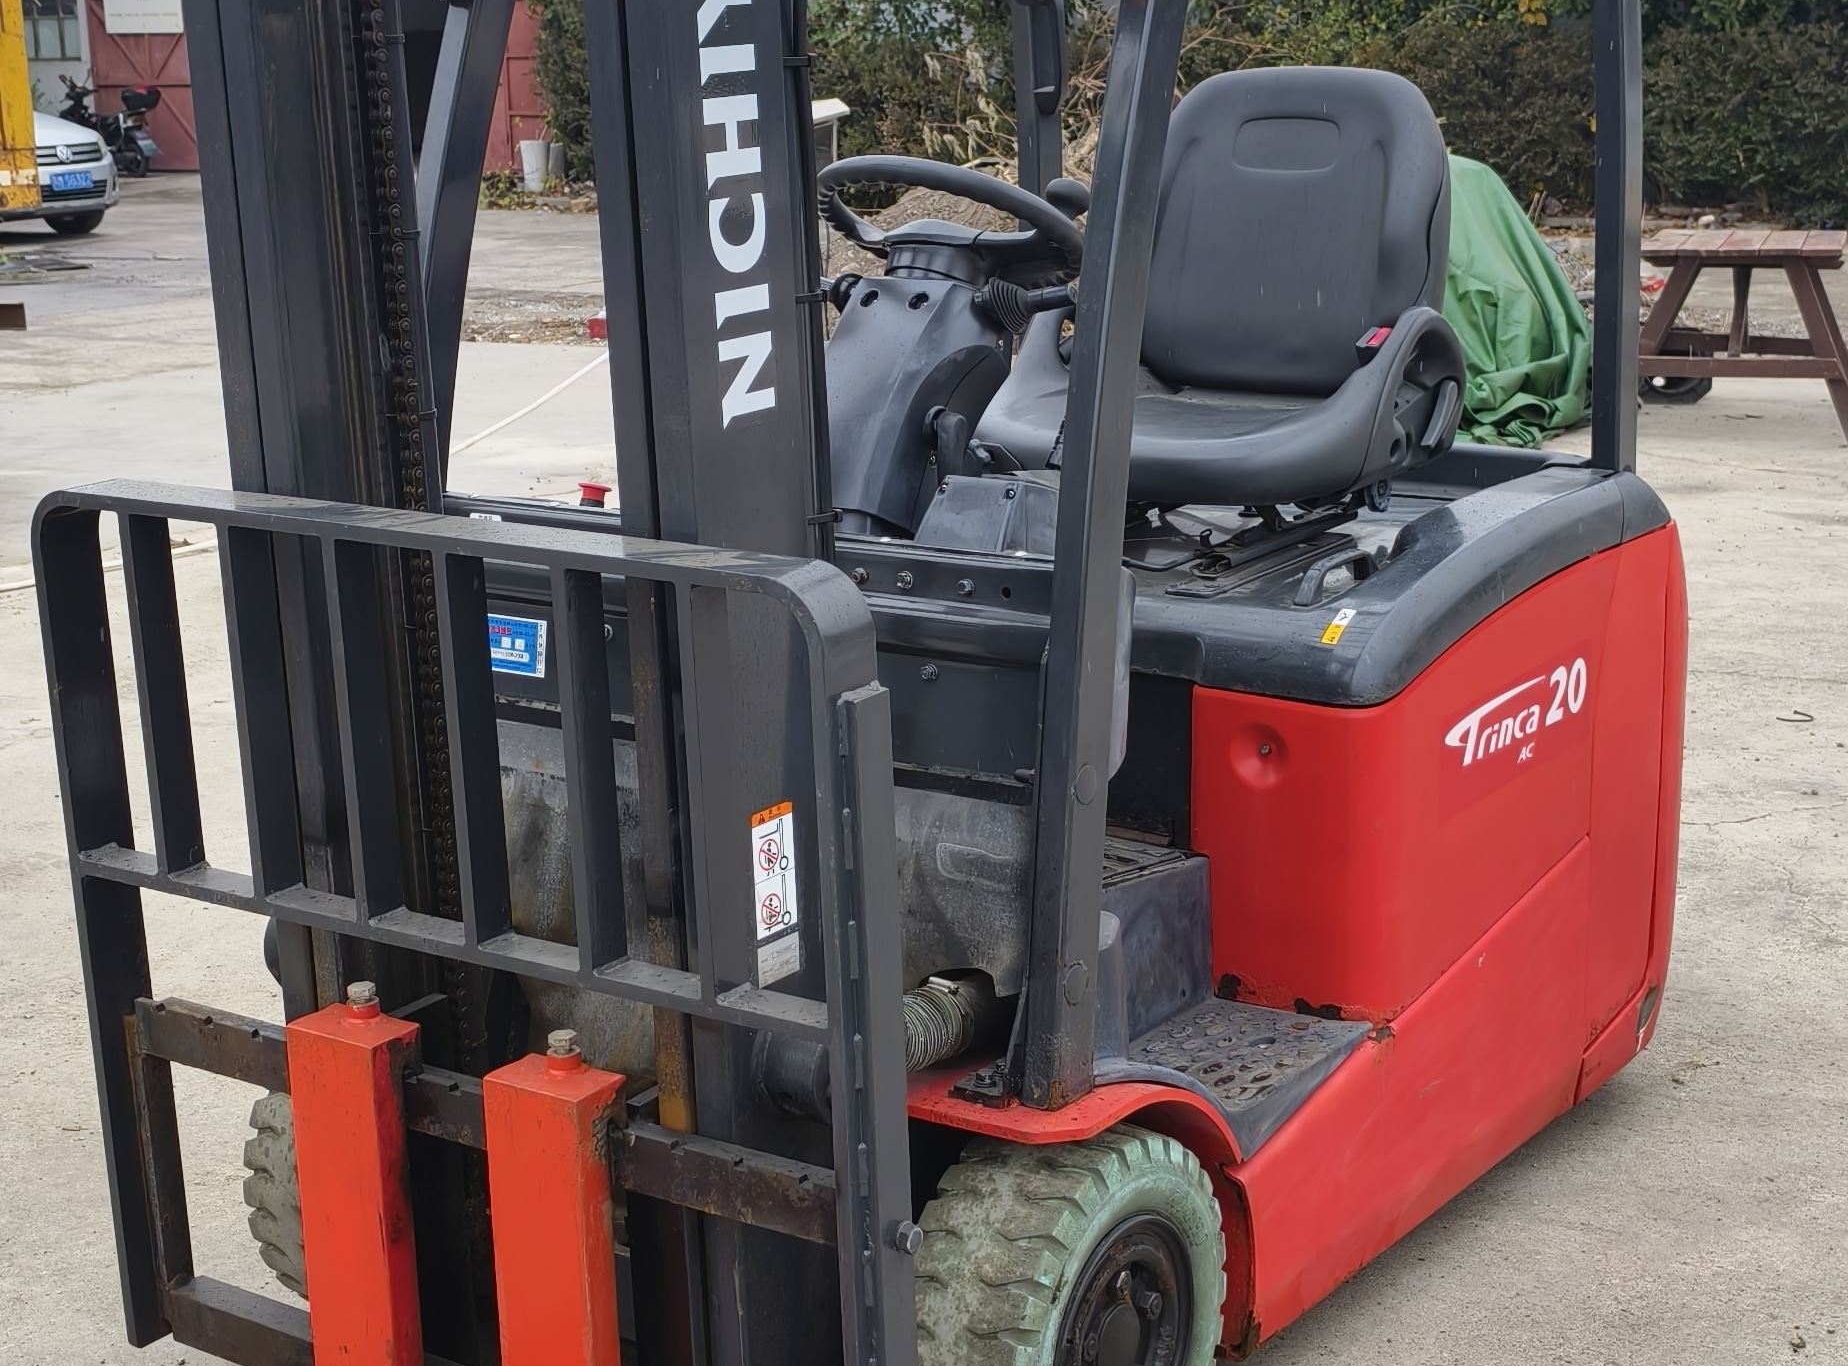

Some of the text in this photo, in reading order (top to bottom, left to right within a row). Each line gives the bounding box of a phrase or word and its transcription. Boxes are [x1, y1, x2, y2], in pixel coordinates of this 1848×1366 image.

[1444, 657, 1587, 767] Trinca 20
[1517, 742, 1536, 764] AC
